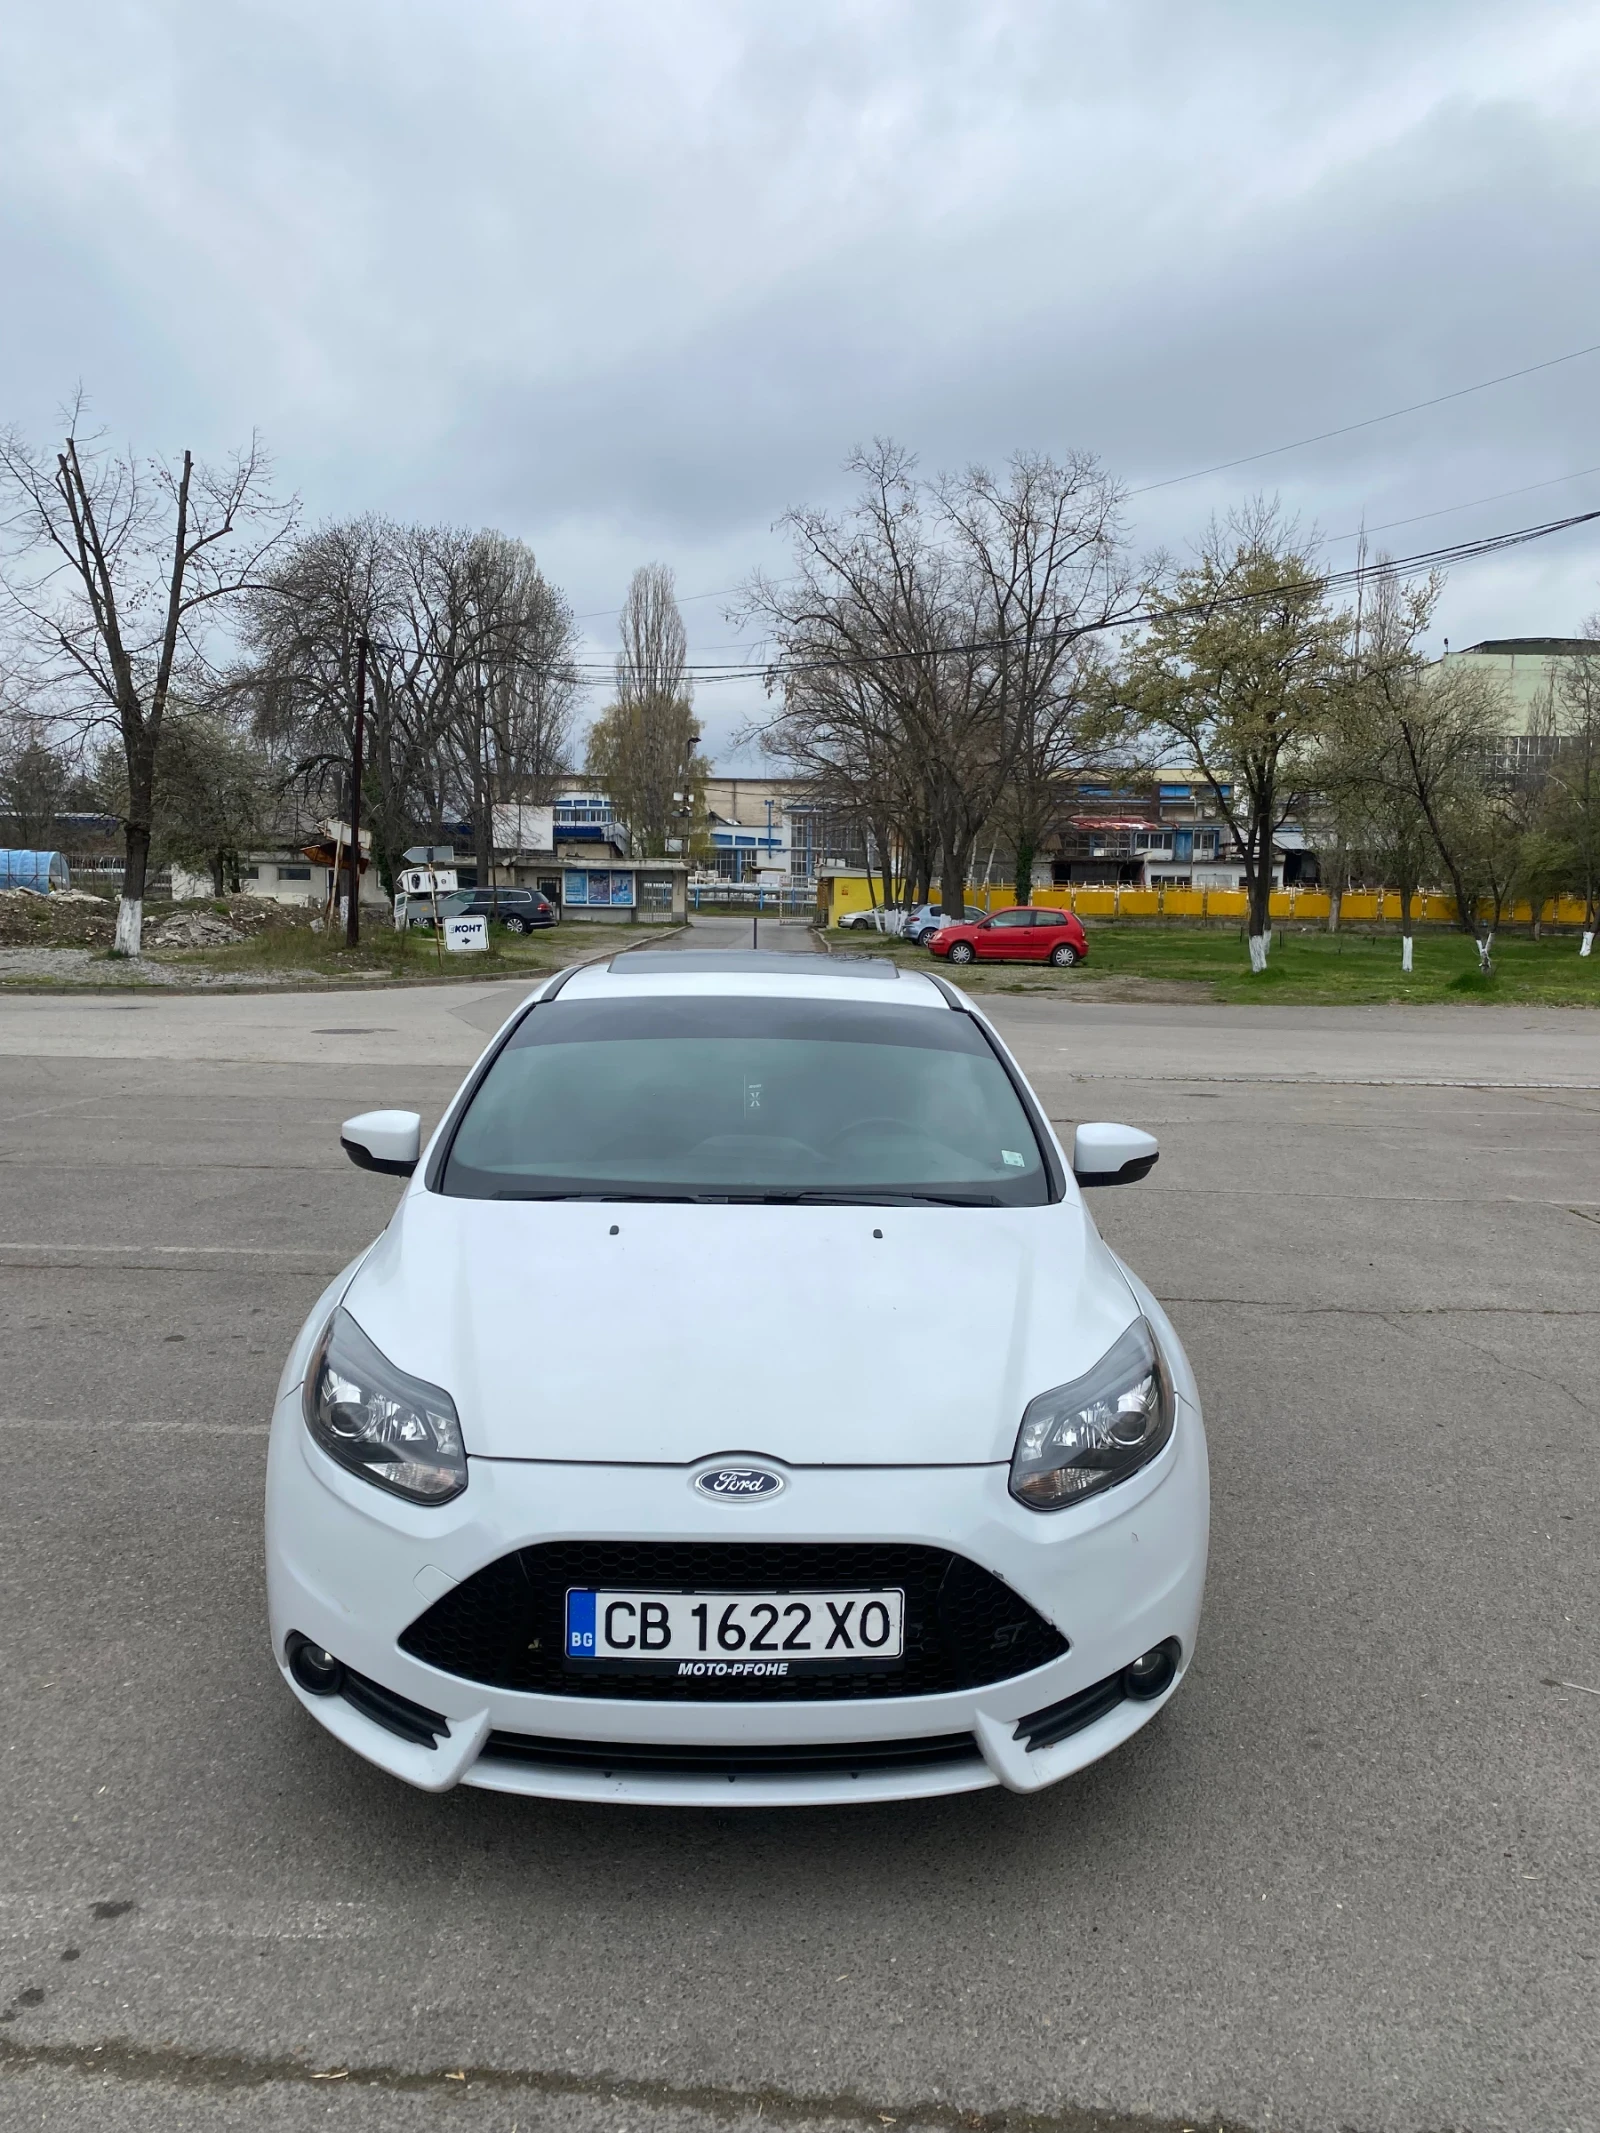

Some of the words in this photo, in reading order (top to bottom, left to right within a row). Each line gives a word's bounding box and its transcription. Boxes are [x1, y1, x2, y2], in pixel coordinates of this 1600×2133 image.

[713, 1471, 765, 1491] Ford
[604, 1601, 671, 1650] CB
[691, 1603, 811, 1651] 1622
[824, 1601, 890, 1649] XO
[990, 1621, 1028, 1650] ST
[571, 1632, 593, 1647] BG
[678, 1663, 788, 1676] MOTO-PFOHE
